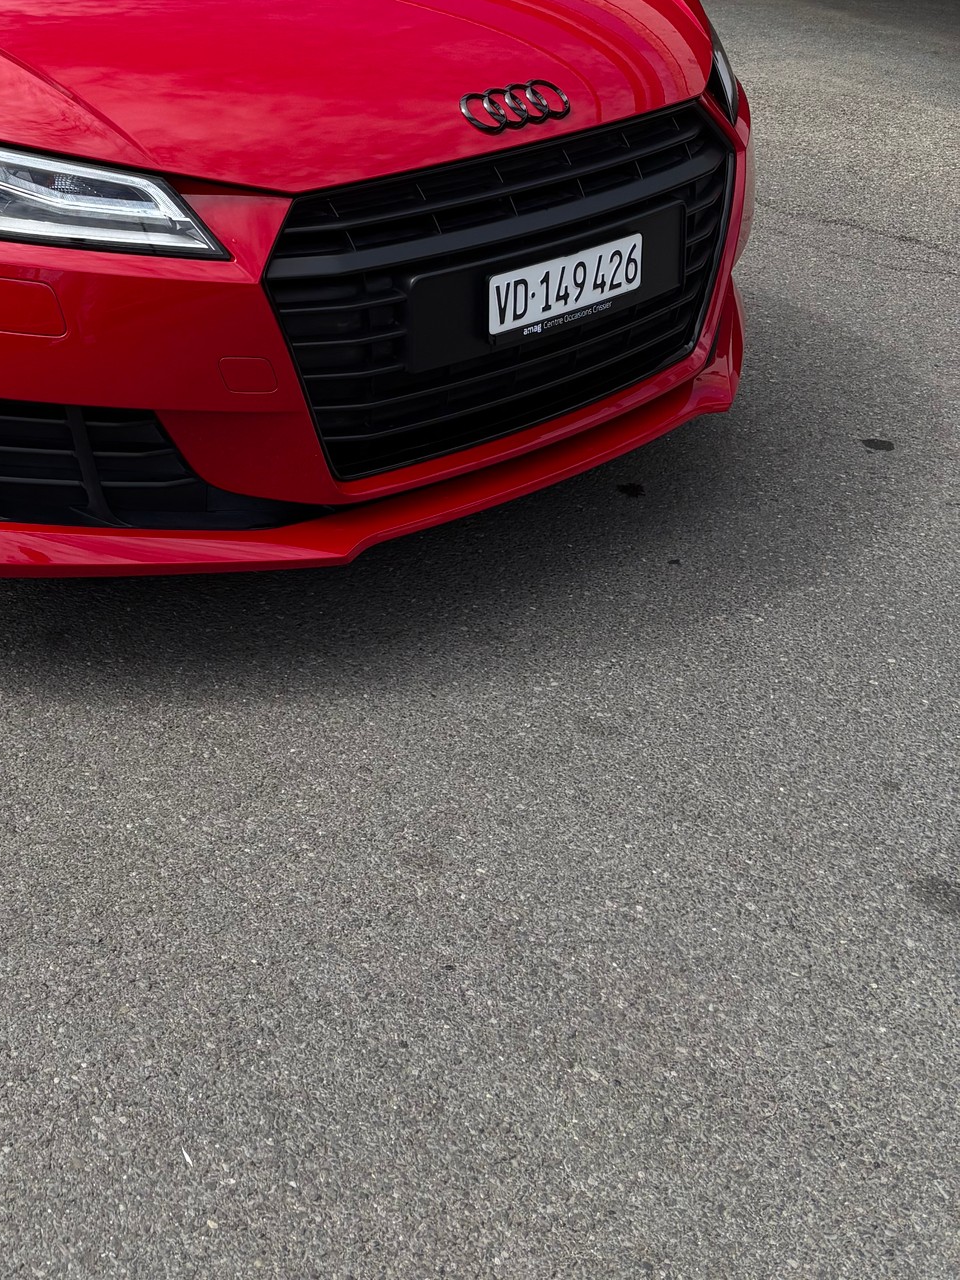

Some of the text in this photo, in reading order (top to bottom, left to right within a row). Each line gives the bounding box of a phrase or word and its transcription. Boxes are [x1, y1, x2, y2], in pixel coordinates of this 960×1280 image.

[523, 301, 612, 335] amag Centre Occasions Crissier
